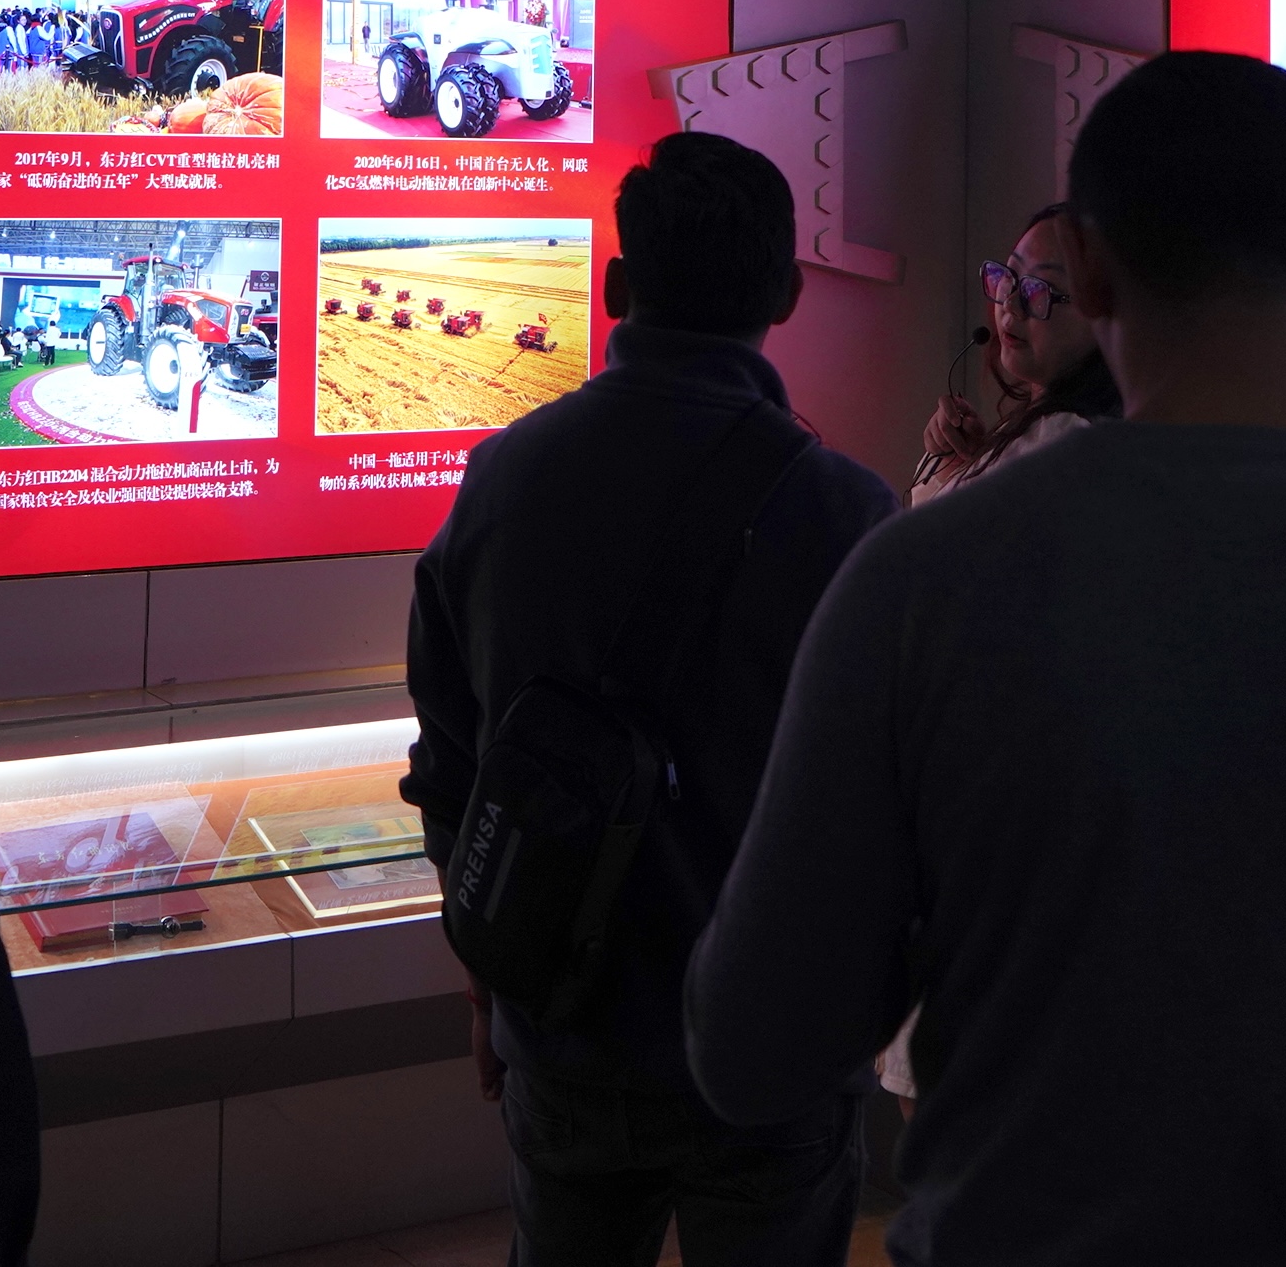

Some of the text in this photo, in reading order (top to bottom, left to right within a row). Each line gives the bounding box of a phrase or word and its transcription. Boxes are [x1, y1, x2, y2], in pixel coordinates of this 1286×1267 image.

[14, 150, 280, 170] 2017年9月，东方红CVT重型拖拉机亮相
[354, 153, 588, 174] 2020年6月16日，中国首台无人化、网联
[325, 174, 557, 193] 化5G氢燃料电动拖拉机在创新中心诞生。
[458, 801, 503, 910] PRENSA
